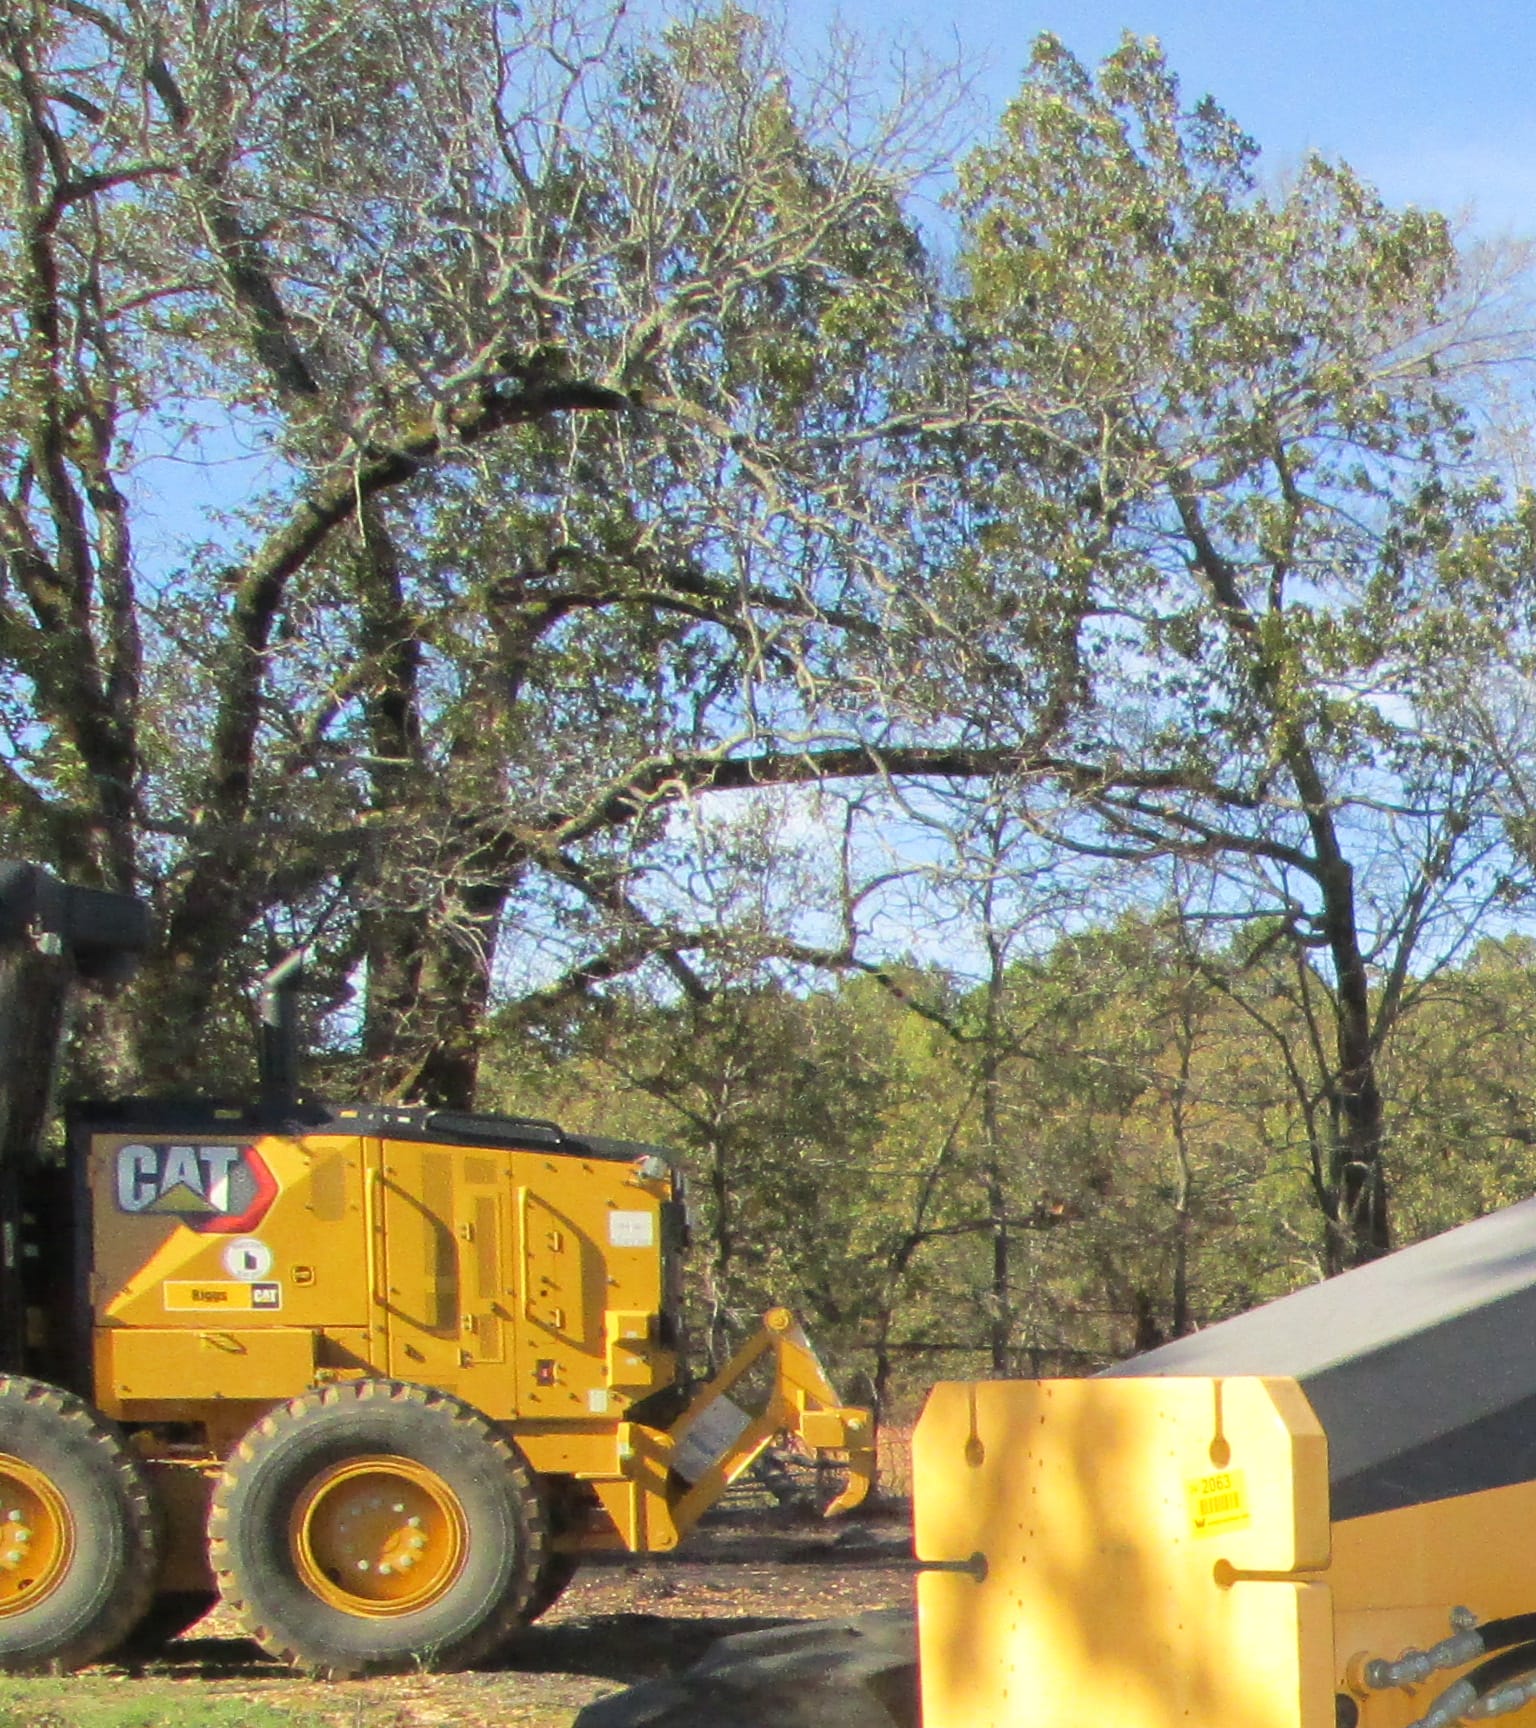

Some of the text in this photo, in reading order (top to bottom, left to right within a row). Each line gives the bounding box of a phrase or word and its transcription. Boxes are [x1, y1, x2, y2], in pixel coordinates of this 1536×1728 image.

[117, 1144, 239, 1213] CAT
[253, 1289, 277, 1304] CAT
[1201, 1473, 1231, 1494] 2063
